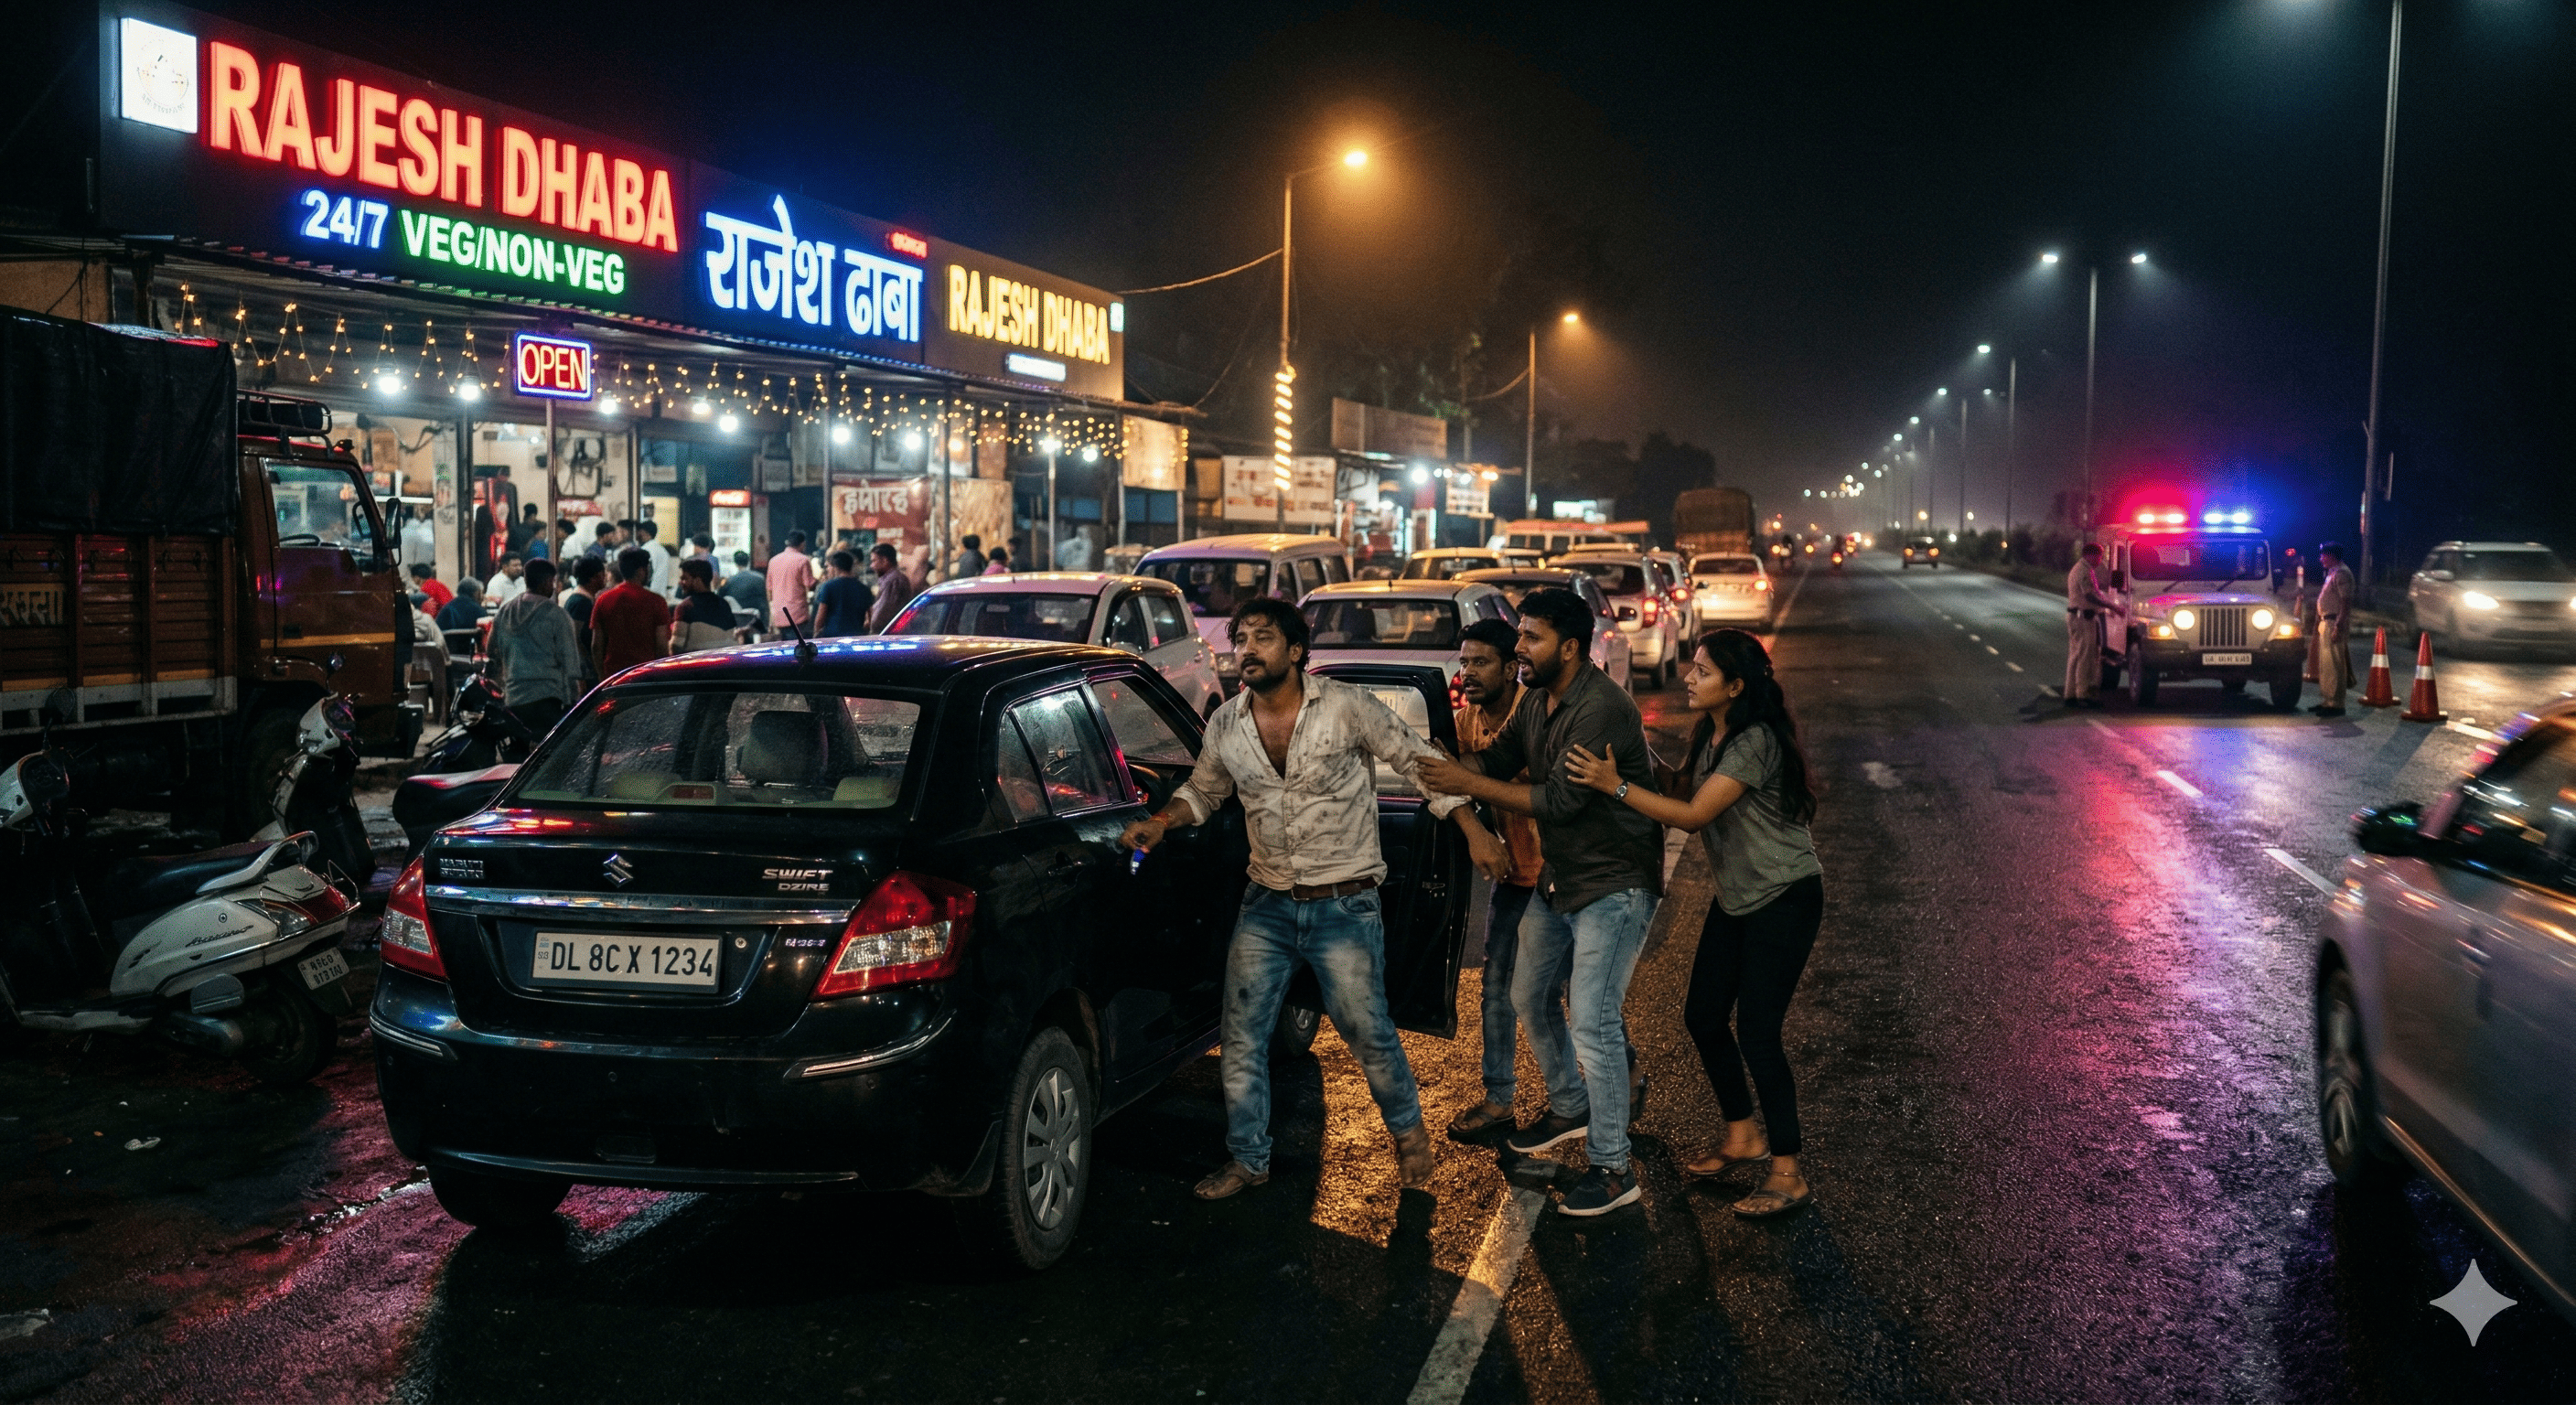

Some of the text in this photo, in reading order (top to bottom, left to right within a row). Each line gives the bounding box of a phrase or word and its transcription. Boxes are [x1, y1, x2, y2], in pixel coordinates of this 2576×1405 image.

[209, 41, 678, 252] RAJESH DHABA
[301, 189, 625, 295] 24/7 VEG/NON-VEG
[706, 194, 923, 342] राजेश ढाबा
[949, 264, 1111, 365] RAJESH DHABA
[521, 343, 586, 391] OPEN
[762, 868, 833, 880] SWIFT
[778, 883, 830, 891] DZIRE
[551, 942, 714, 977] DL 8C X 1234
